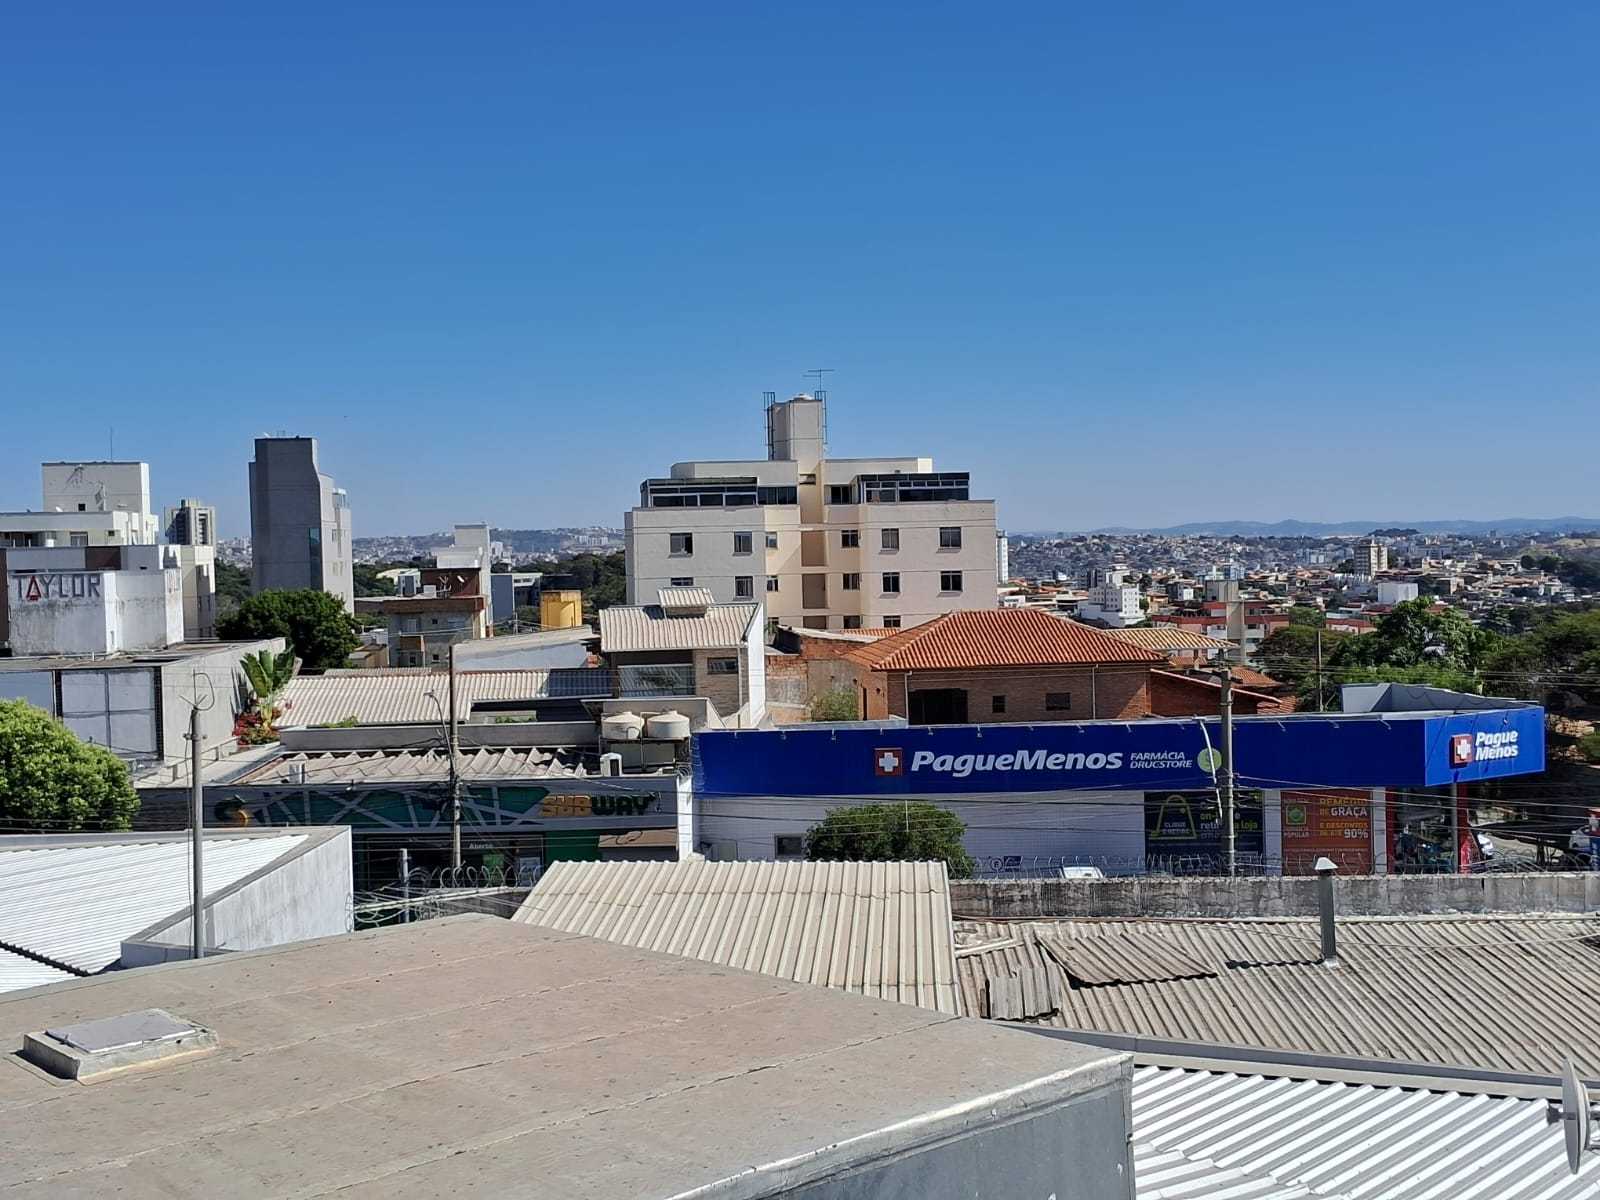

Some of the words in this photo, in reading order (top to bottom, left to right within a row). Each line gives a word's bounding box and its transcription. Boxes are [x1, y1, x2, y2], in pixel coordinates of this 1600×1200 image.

[15, 575, 101, 601] TAYLOR
[1475, 730, 1519, 747] Pague
[1130, 750, 1185, 761] FARMÁCIA
[1475, 744, 1519, 761] Menos
[911, 749, 1123, 778] PagueMenos
[1130, 760, 1192, 769] DRUGSTORE
[542, 792, 656, 817] SUBWAY
[1331, 806, 1368, 818] GRAÇA
[1344, 828, 1369, 839] 90%
